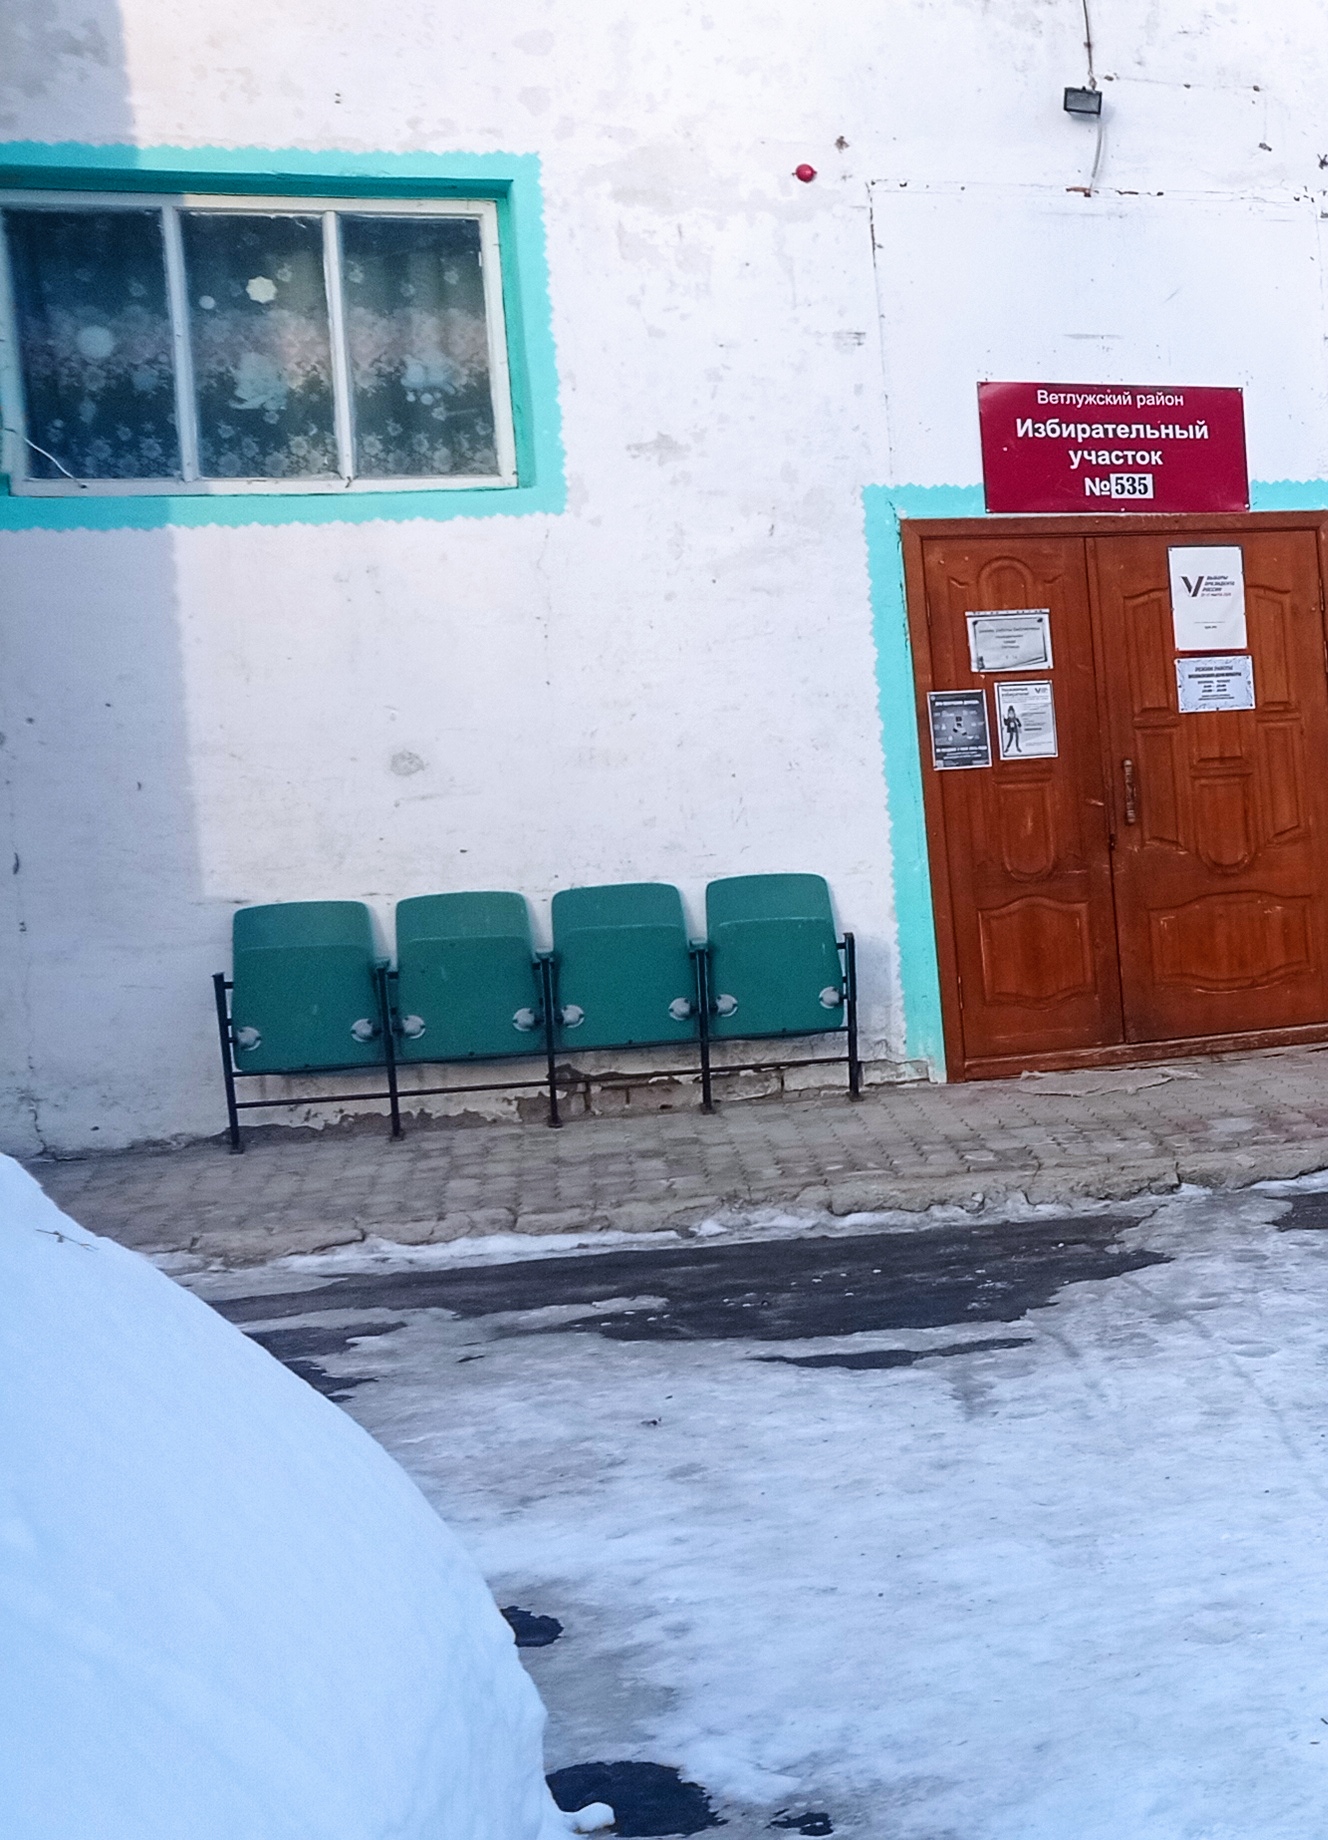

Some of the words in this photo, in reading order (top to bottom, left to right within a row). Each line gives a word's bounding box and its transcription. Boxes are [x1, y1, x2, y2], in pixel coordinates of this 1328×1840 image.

[1037, 389, 1132, 408] Ветлужский
[1137, 391, 1184, 408] район
[1015, 418, 1209, 442] Избирательный
[1068, 449, 1163, 469] участок
